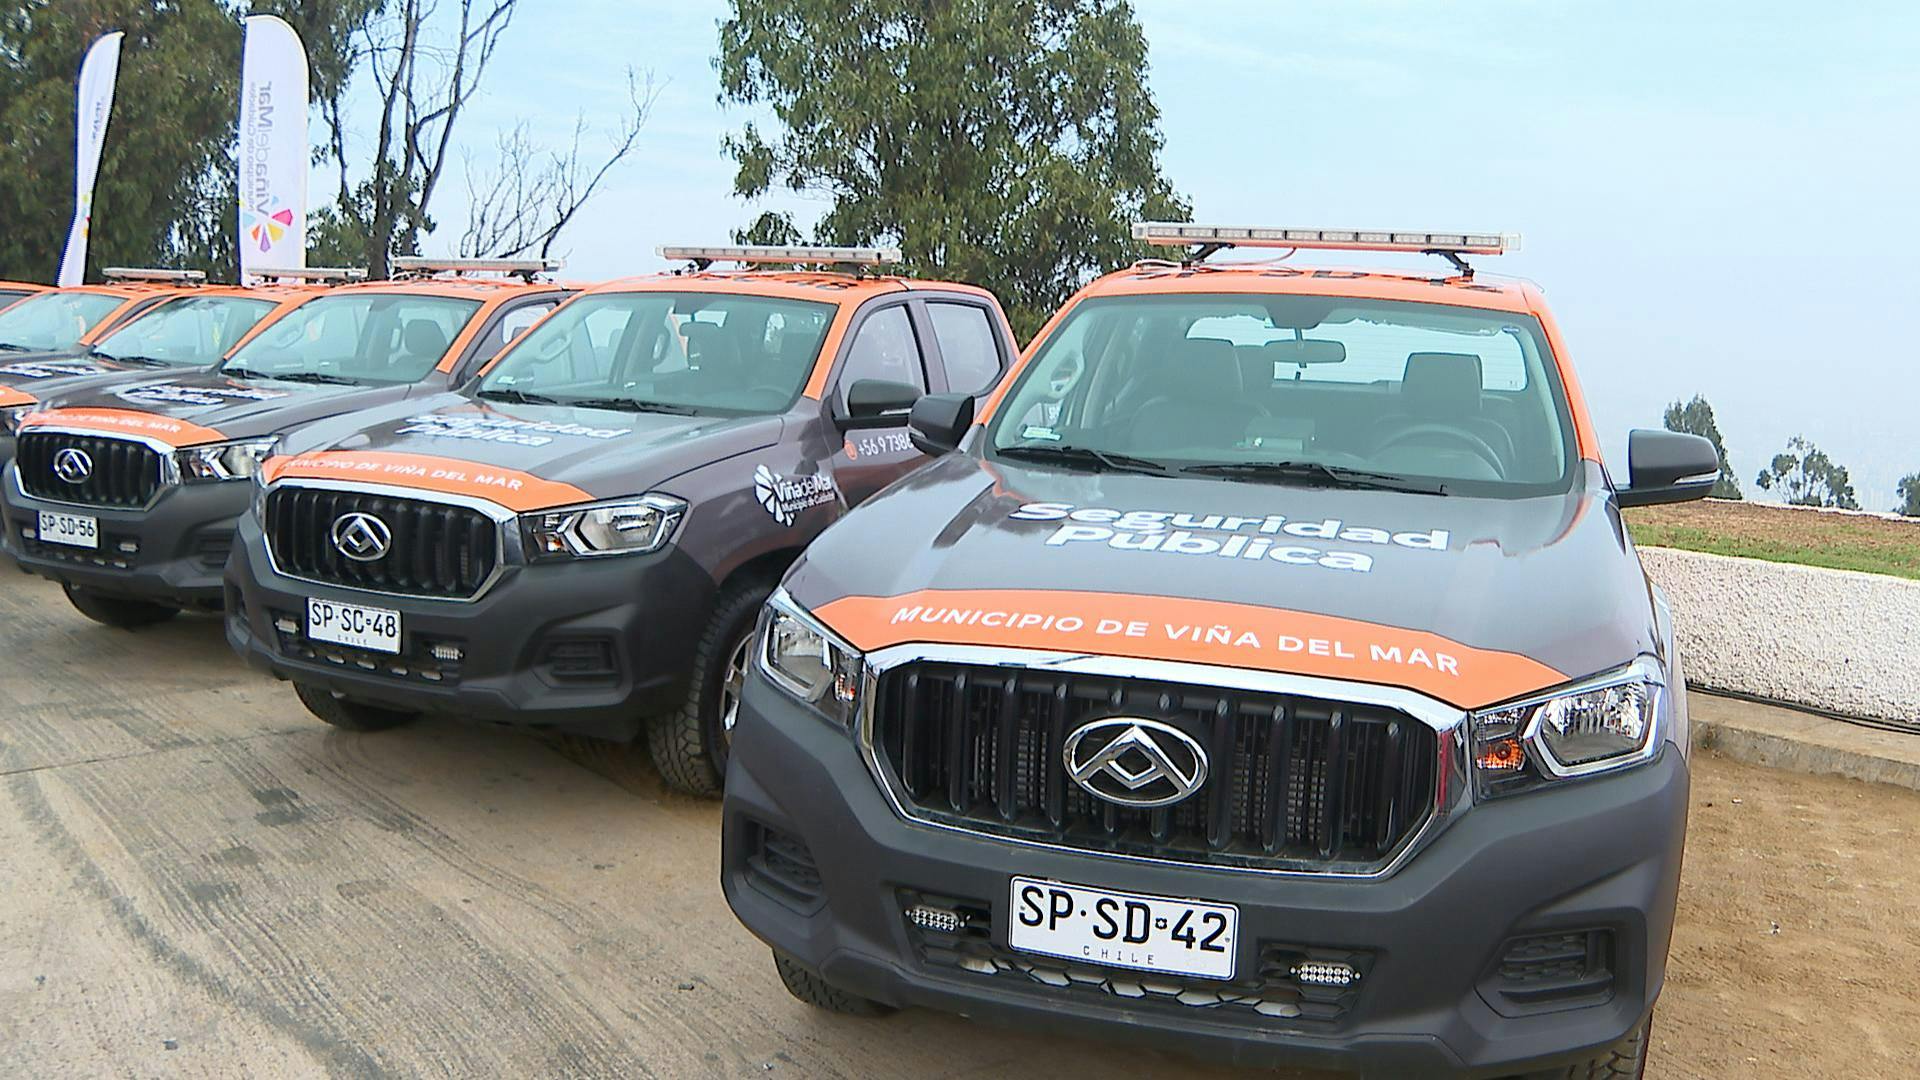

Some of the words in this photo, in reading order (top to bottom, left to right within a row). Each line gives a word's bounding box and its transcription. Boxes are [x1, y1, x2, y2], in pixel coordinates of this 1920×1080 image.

[858, 438, 879, 456] +56
[877, 436, 886, 453] 9
[383, 462, 426, 478] VIÑA
[430, 469, 468, 482] DEL
[474, 473, 524, 491] MAR
[1008, 502, 1450, 552] Seguridad
[1044, 524, 1375, 572] Pública
[890, 605, 1084, 633] MUNICIPIO
[1095, 618, 1150, 637] DE
[1163, 624, 1262, 649] VIÑA
[1277, 634, 1356, 659] DEL
[1369, 643, 1461, 677] MAR
[1082, 945, 1155, 966] CHILE
